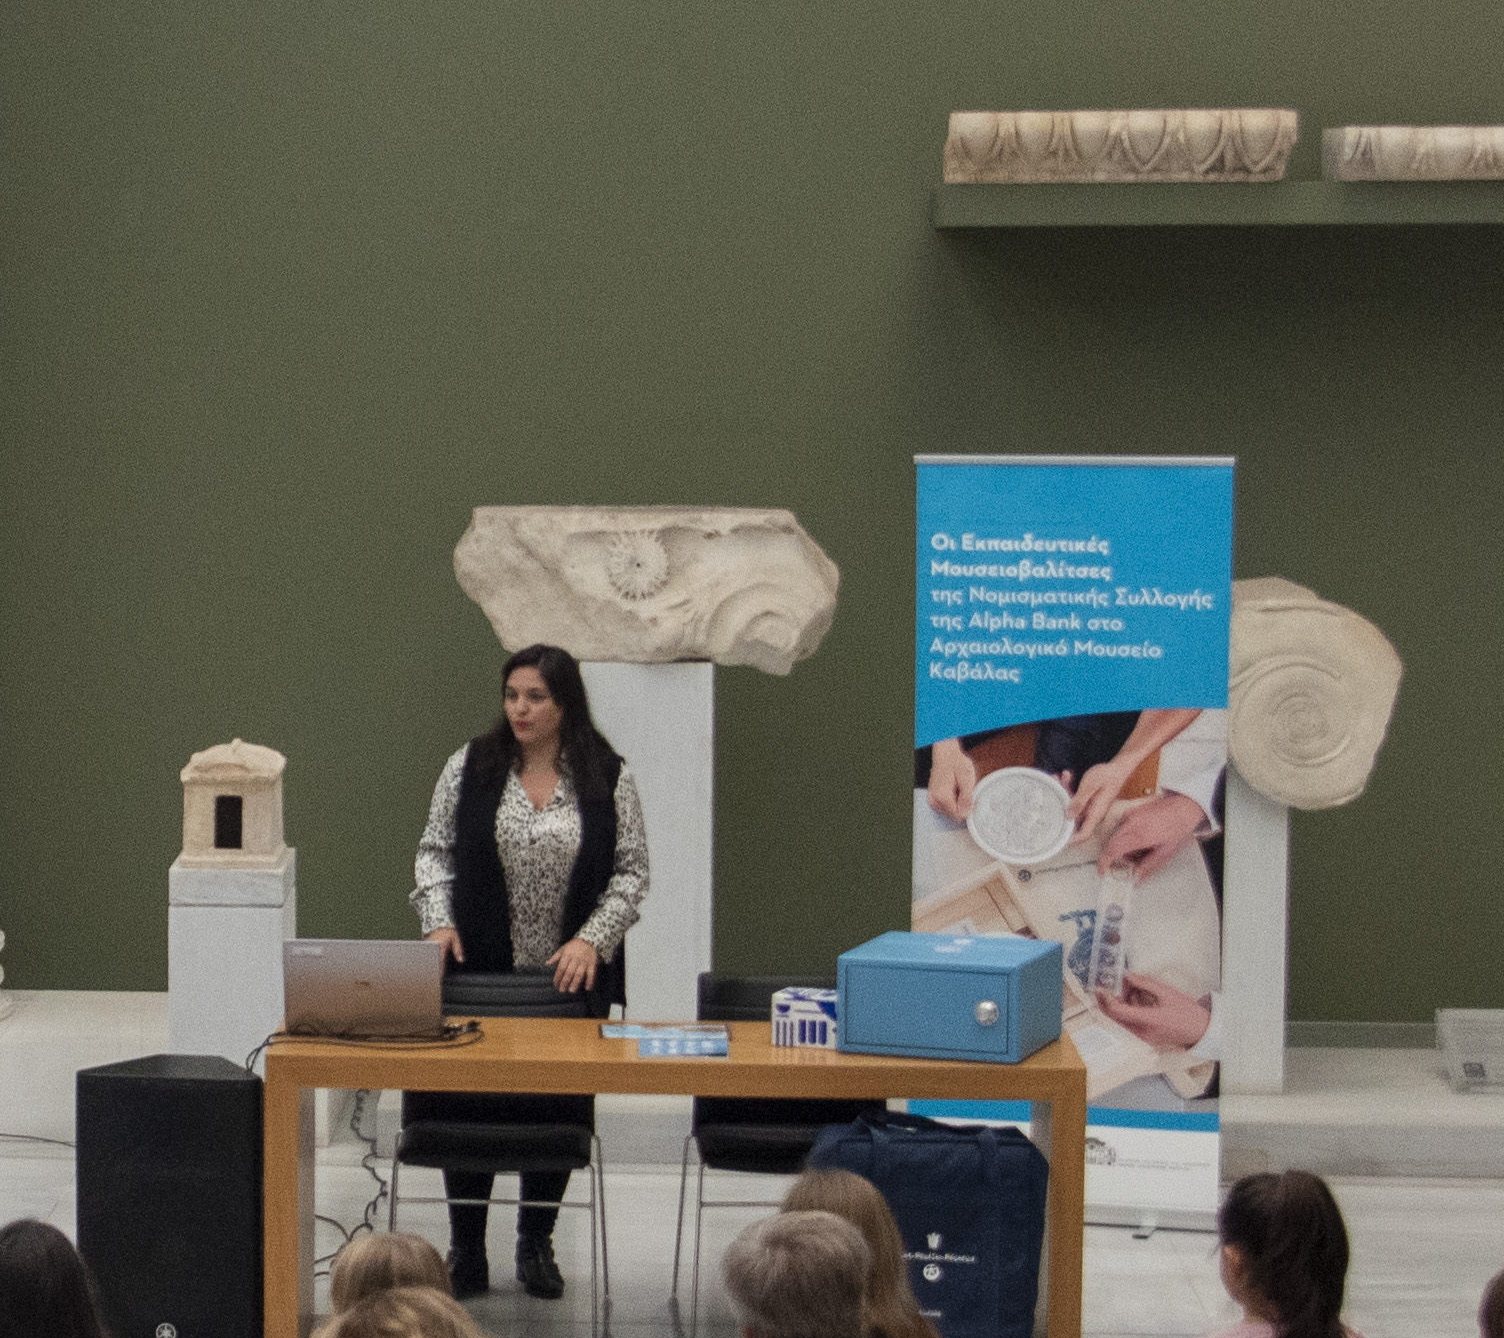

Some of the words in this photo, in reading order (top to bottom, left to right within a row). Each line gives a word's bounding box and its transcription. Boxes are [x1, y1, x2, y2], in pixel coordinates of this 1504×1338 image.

[930, 533, 956, 551] Οι
[961, 532, 1110, 556] Εκπαιδευτικές
[930, 558, 1112, 582] Μουσειοβαλίτσες
[930, 588, 962, 606] της
[968, 586, 1110, 609] Νομισματικής
[1114, 587, 1214, 610] Συλλογής
[930, 614, 962, 632] της
[968, 611, 1025, 632] Alpha
[1031, 612, 1081, 631] Bank
[1086, 617, 1125, 631] στο
[929, 637, 1069, 659] Αρχαιολογικό
[1073, 638, 1163, 659] Μουσείο
[929, 660, 1021, 683] Καβάλας
